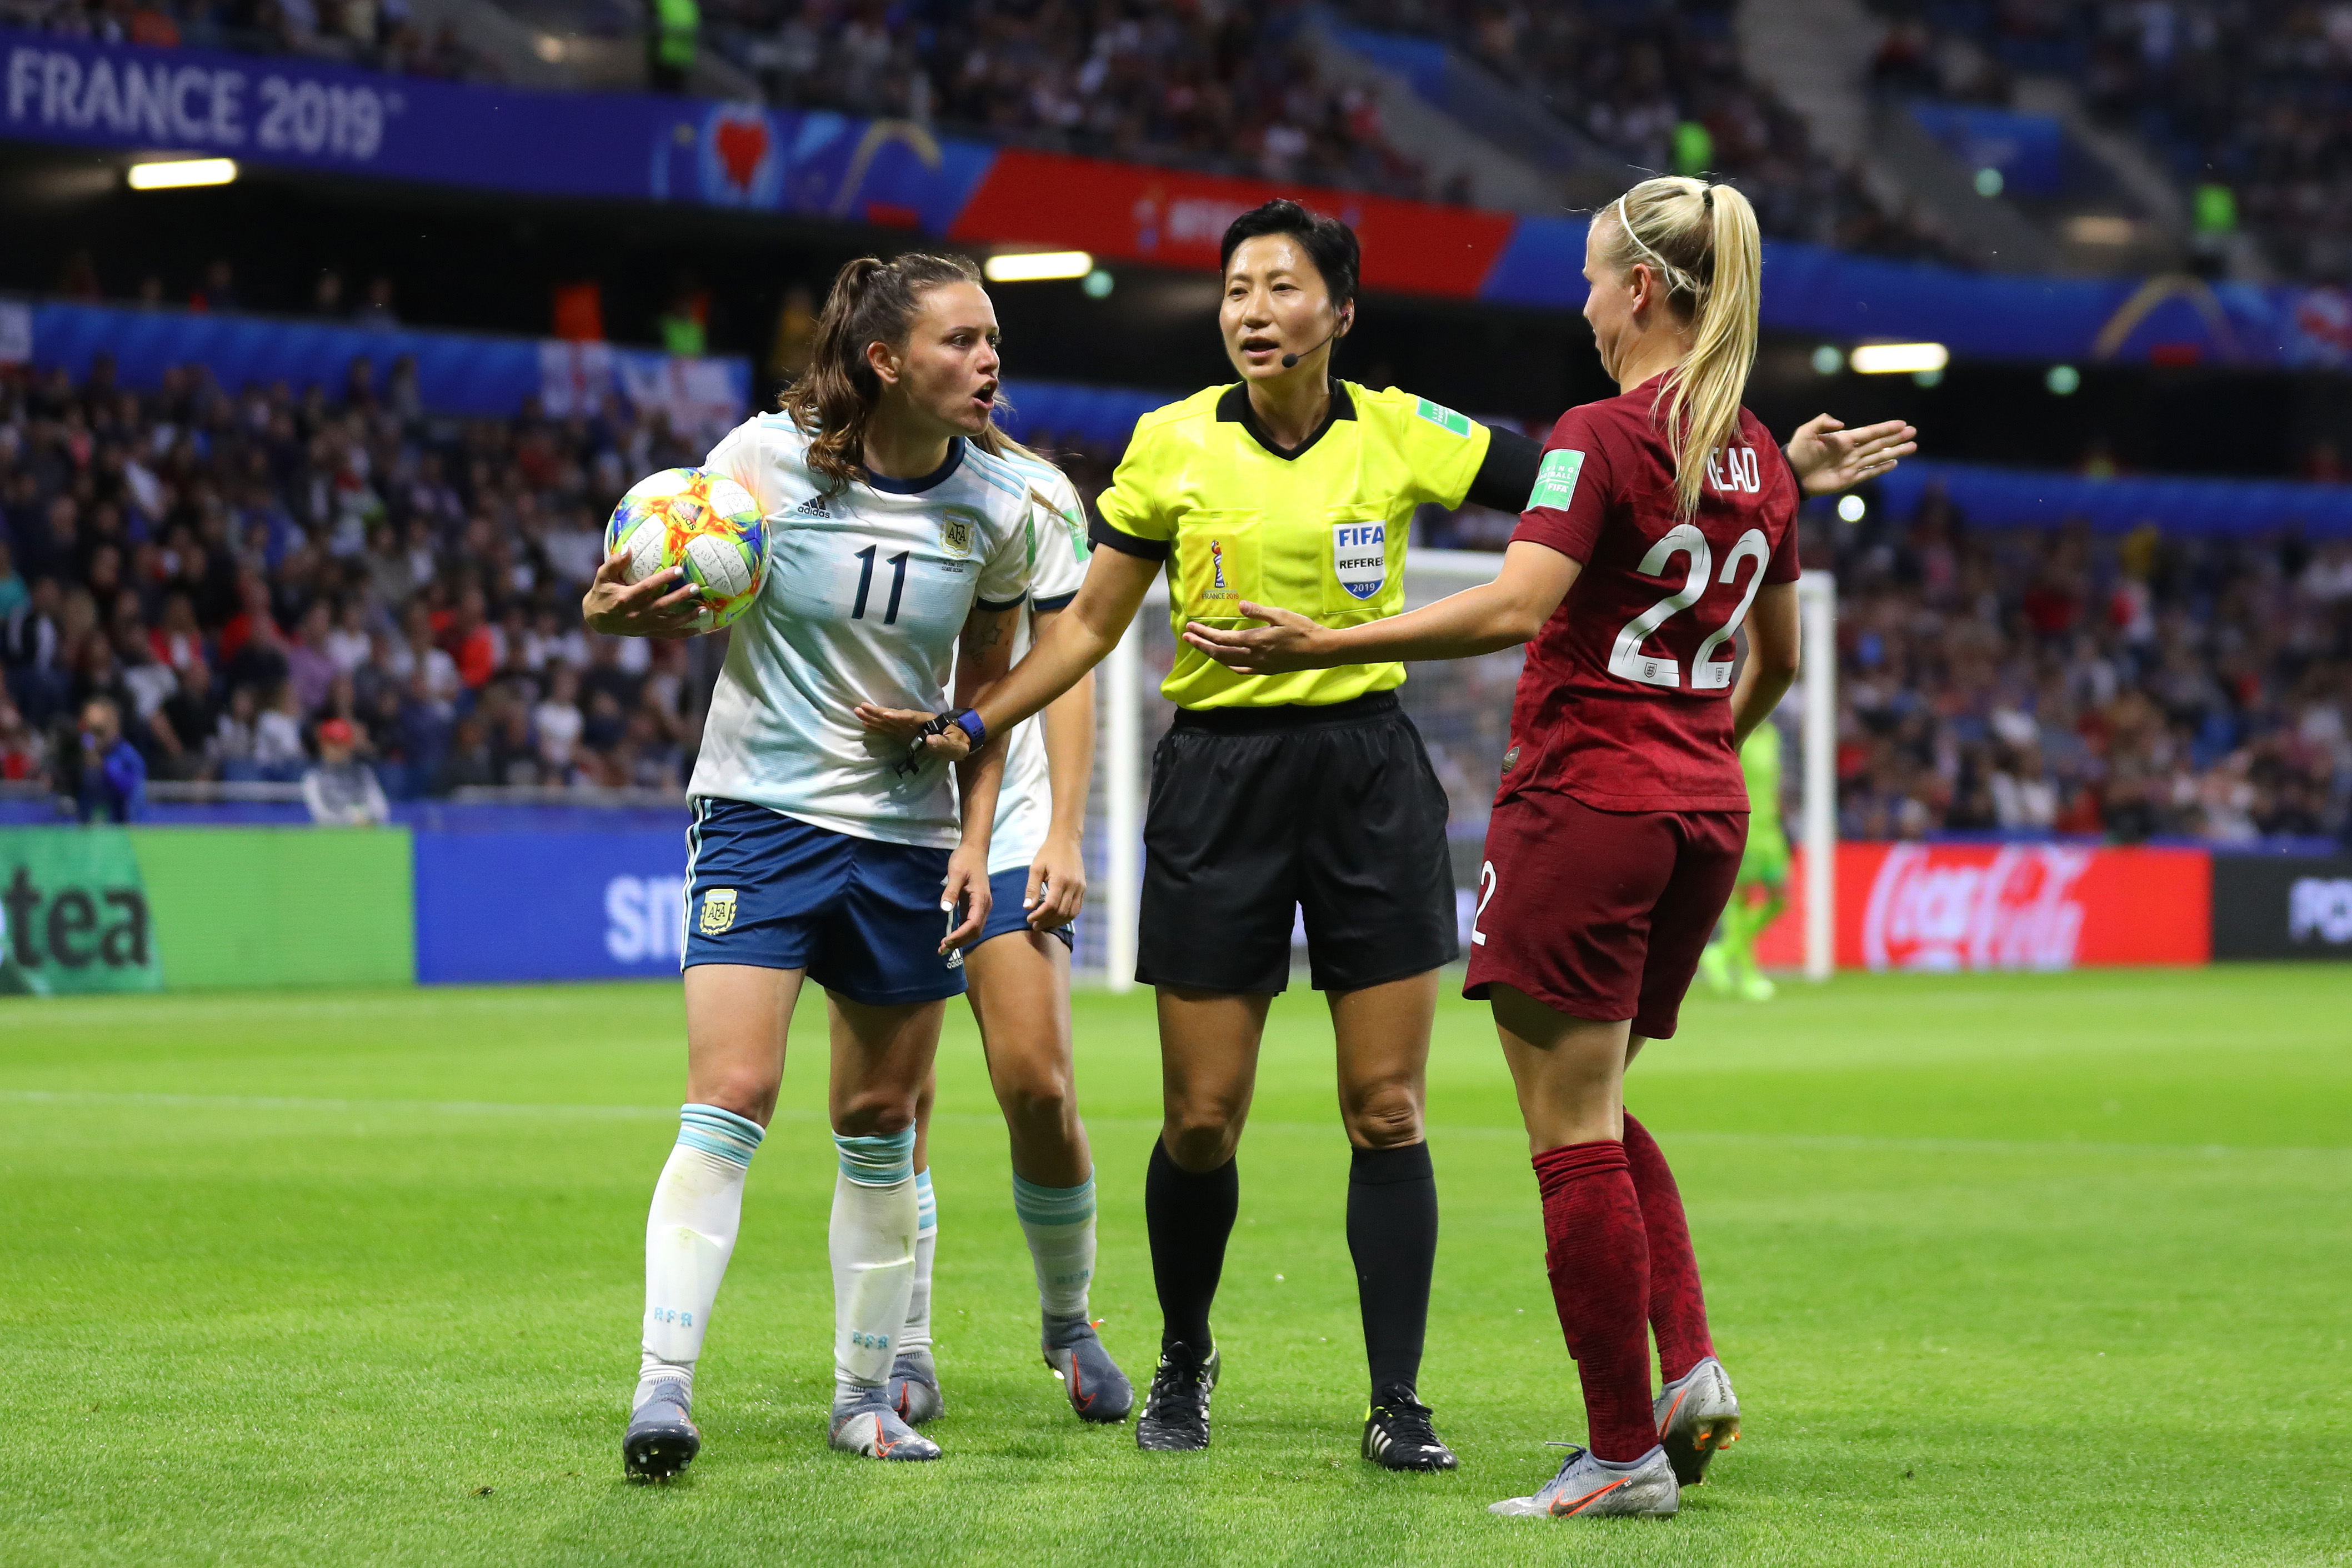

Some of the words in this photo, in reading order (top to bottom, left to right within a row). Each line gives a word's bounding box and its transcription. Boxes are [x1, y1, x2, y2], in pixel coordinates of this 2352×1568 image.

[7, 48, 247, 146] FRANCE
[798, 505, 830, 519] adidas
[1548, 483, 1568, 493] FIFA
[1339, 525, 1385, 547] FIFA
[851, 544, 910, 624] 11
[1352, 582, 1375, 593] 2019
[1608, 524, 1770, 689] 22
[4, 865, 149, 968] tea
[707, 901, 725, 921] AFA
[1471, 860, 1497, 946] 2
